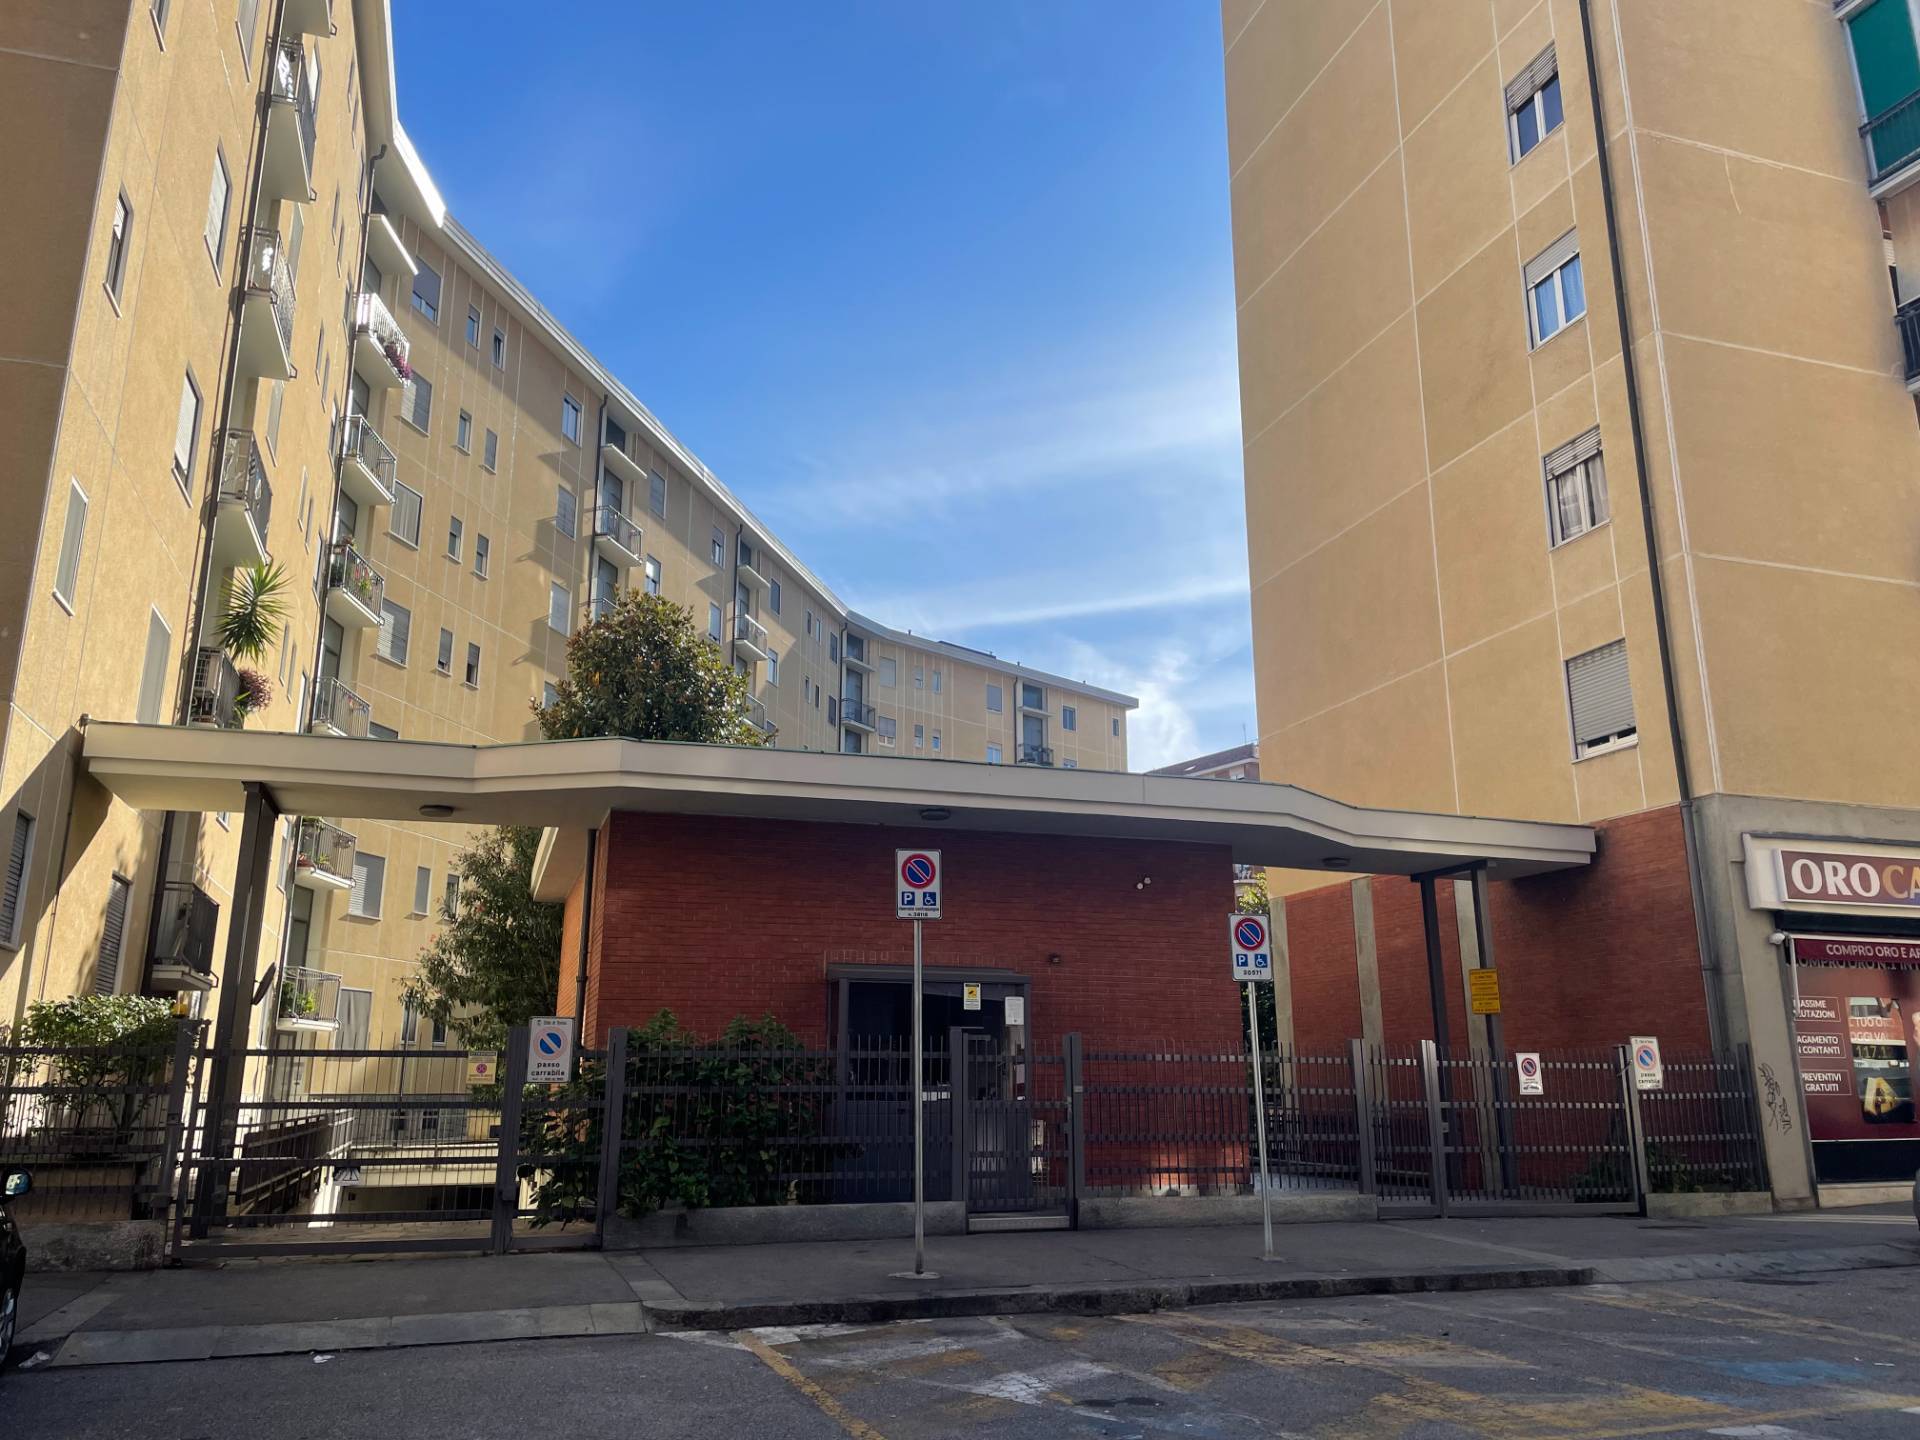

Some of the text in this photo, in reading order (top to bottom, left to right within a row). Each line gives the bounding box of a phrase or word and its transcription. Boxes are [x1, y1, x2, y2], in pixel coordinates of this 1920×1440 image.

[1826, 944, 1874, 956] COMPRO
[1875, 946, 1899, 958] ORO
[1900, 947, 1908, 958] E
[1797, 1035, 1839, 1044] AGAMENTO
[1802, 1046, 1841, 1055] CONTANTI
[1805, 1083, 1839, 1092] GRATUITI
